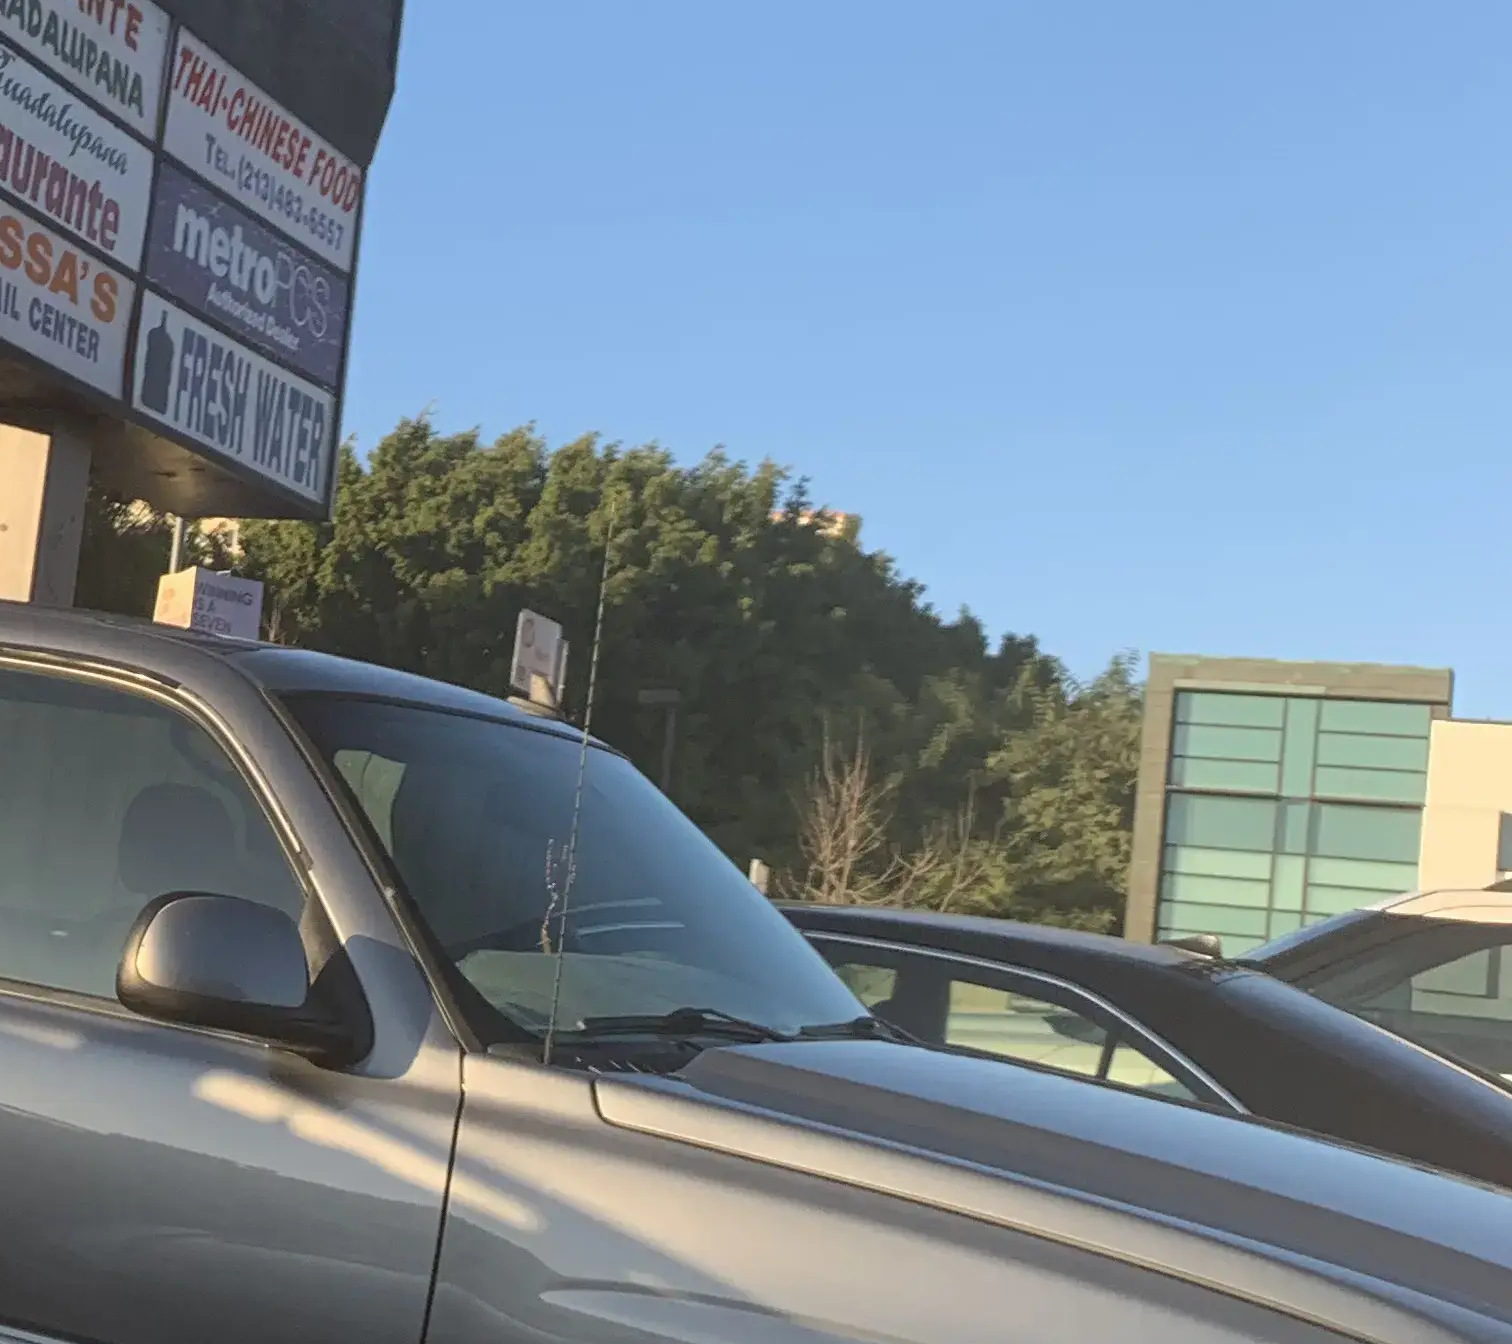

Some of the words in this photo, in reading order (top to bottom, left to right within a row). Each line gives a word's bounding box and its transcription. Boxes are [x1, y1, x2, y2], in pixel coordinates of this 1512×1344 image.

[308, 147, 362, 213] FOOD
[28, 297, 101, 363] CENTER
[174, 326, 253, 457] FRESH
[253, 369, 325, 492] WATER
